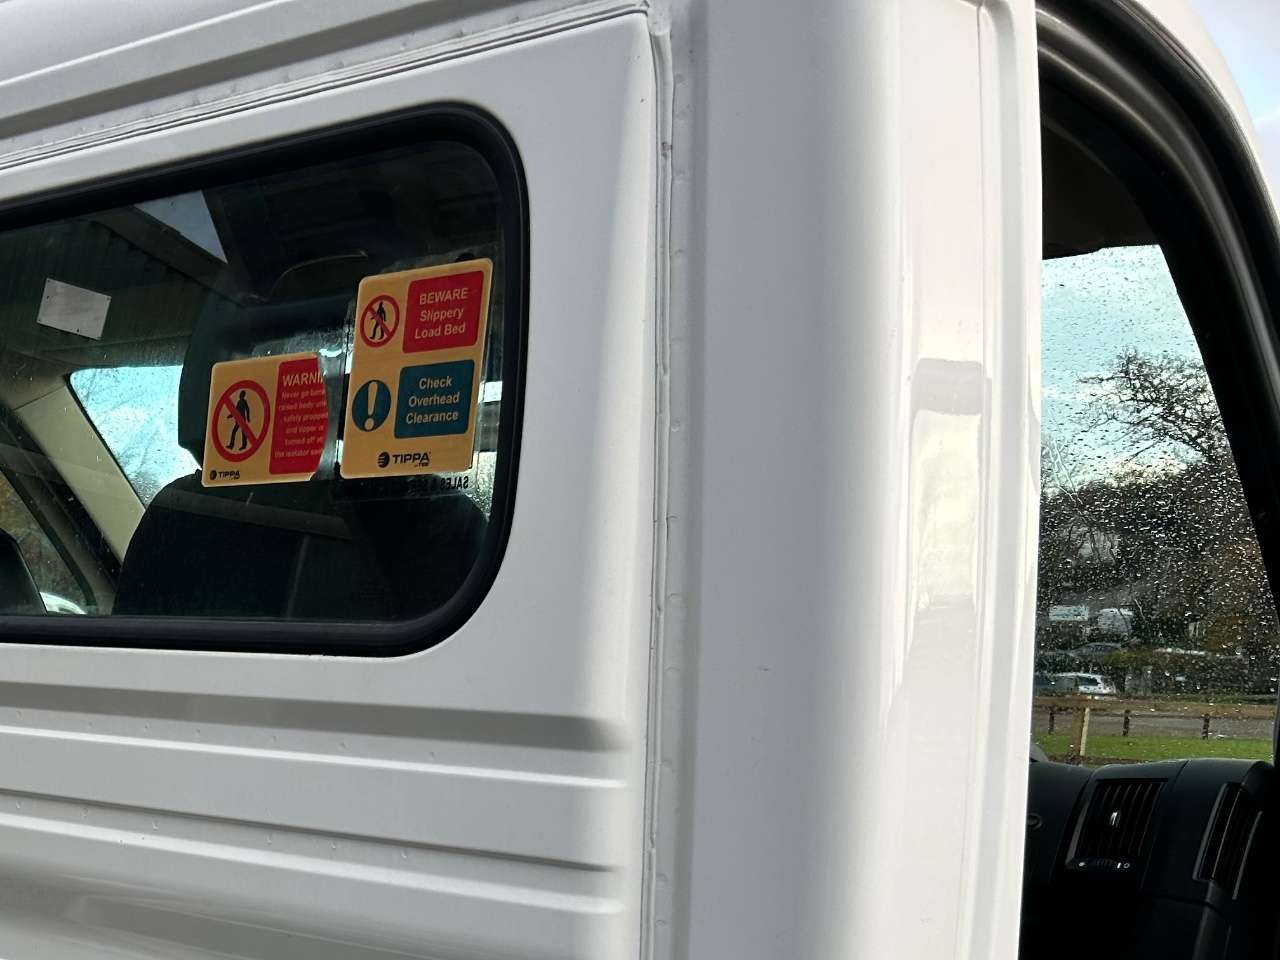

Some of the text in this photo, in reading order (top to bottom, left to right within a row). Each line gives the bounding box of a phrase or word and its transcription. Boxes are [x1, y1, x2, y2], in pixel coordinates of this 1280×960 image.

[419, 287, 468, 305] BEWARE
[420, 308, 464, 323] Slippery
[414, 323, 466, 340] Load Bed
[418, 376, 452, 390] Check
[408, 392, 460, 408] Overhead
[406, 411, 459, 425] Clearance
[392, 452, 431, 465] TIPPA
[218, 471, 241, 479] TIPPA
